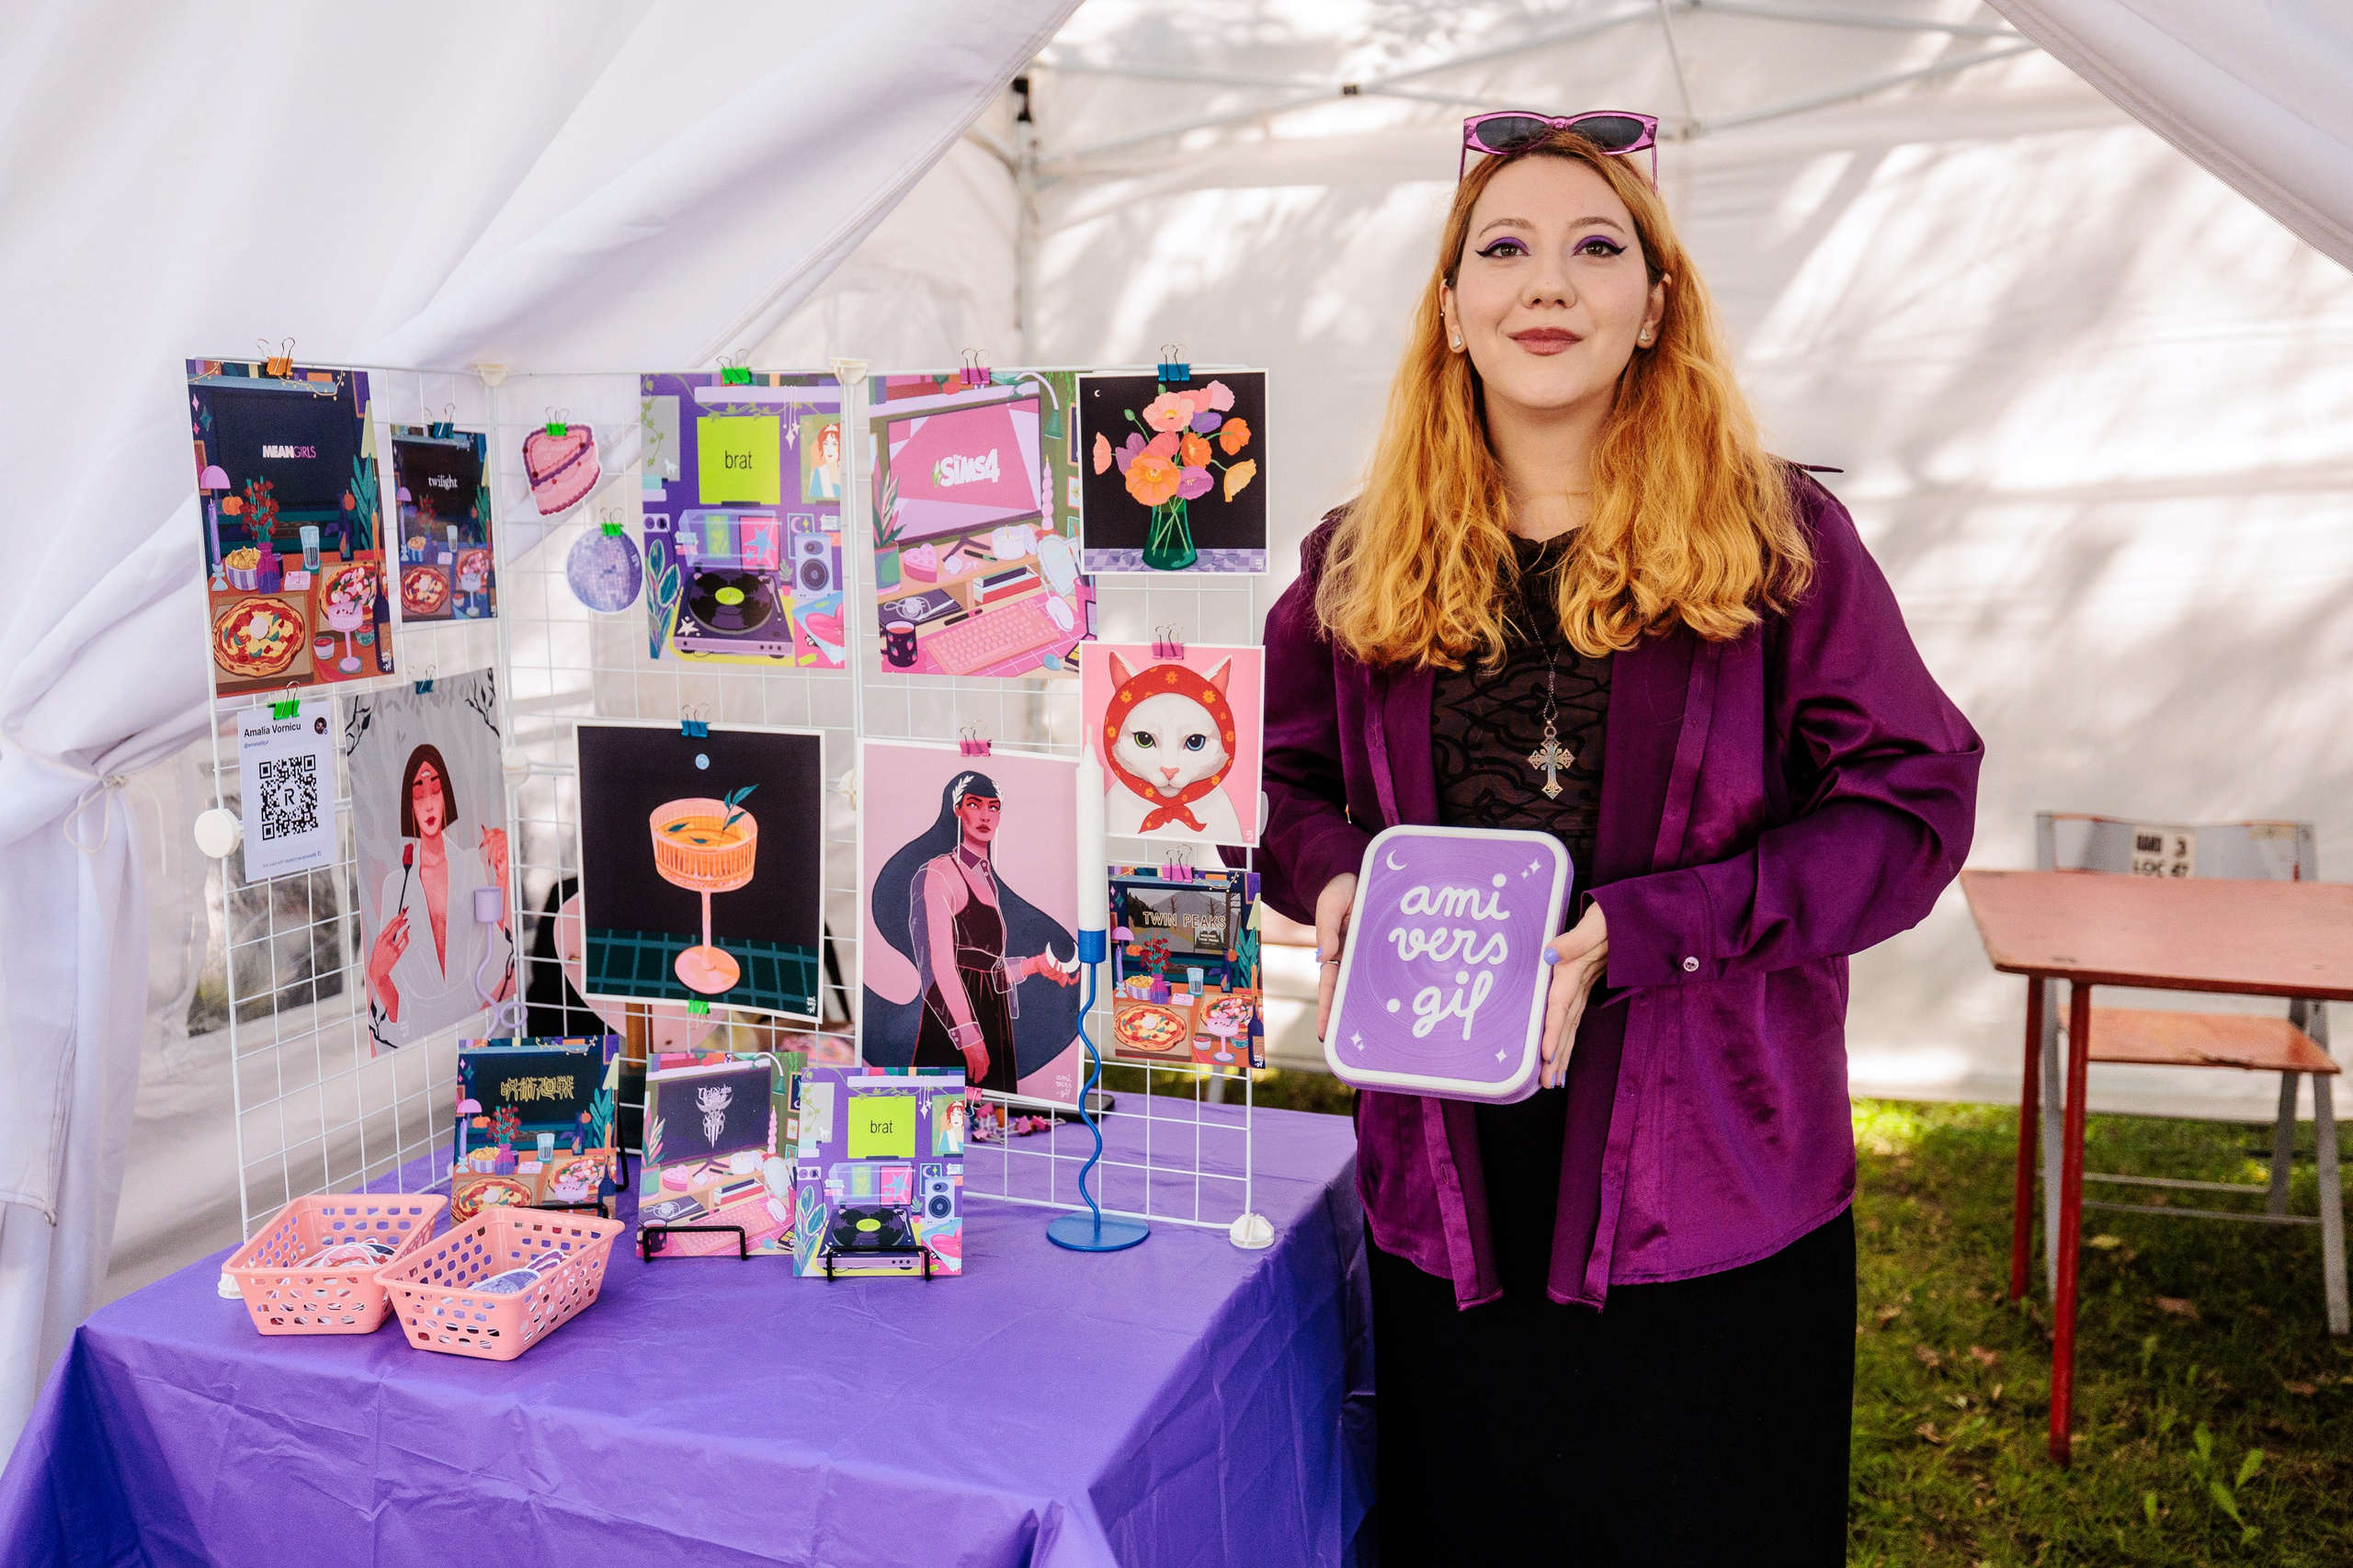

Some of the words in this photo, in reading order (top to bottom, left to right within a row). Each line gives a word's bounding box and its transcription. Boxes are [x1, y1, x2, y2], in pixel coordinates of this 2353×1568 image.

[724, 449, 753, 470] brat
[428, 473, 458, 491] twilight
[244, 725, 270, 738] Amalia
[272, 722, 301, 733] Vornicu
[1399, 873, 1510, 921] ami
[1142, 911, 1176, 926] TWIN
[1183, 913, 1227, 930] PEAKS
[1388, 927, 1508, 965] vers
[870, 1119, 893, 1134] brat
